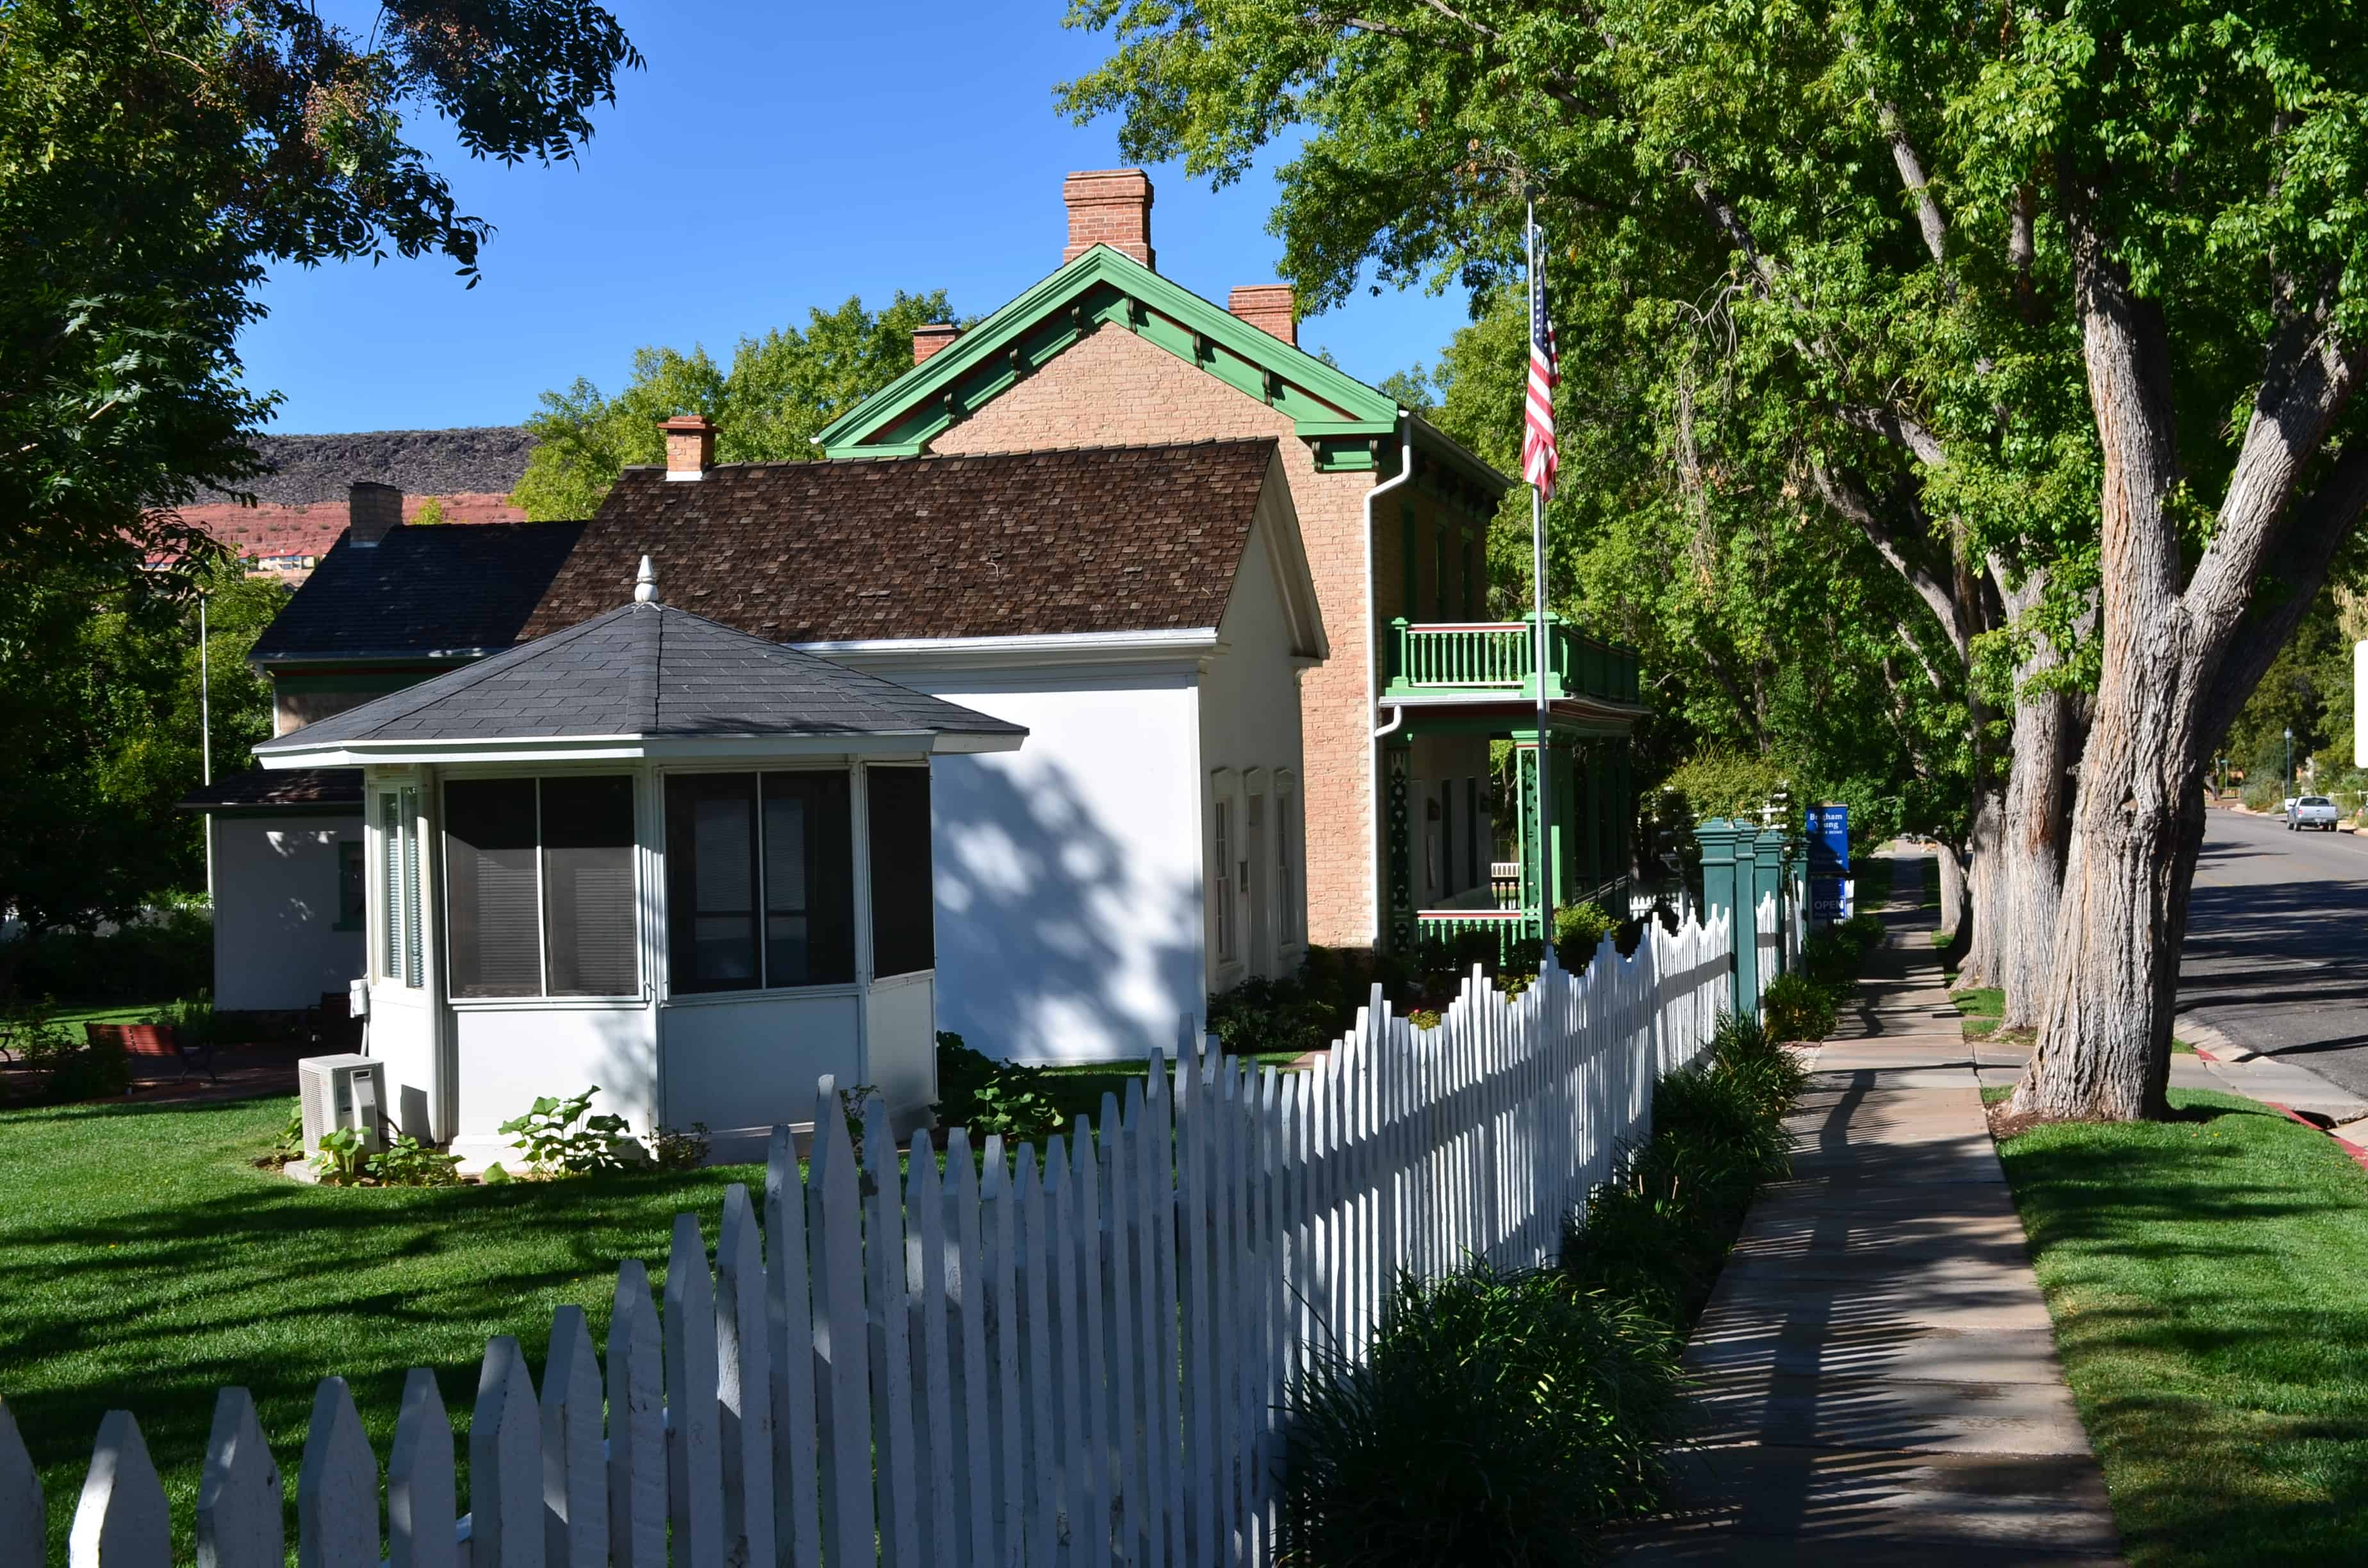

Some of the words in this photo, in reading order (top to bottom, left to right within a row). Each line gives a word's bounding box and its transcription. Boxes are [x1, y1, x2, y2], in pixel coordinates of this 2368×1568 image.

[1809, 813, 1843, 822] Brgham
[1814, 821, 1839, 830] Yung
[1814, 900, 1844, 910] OPEN
